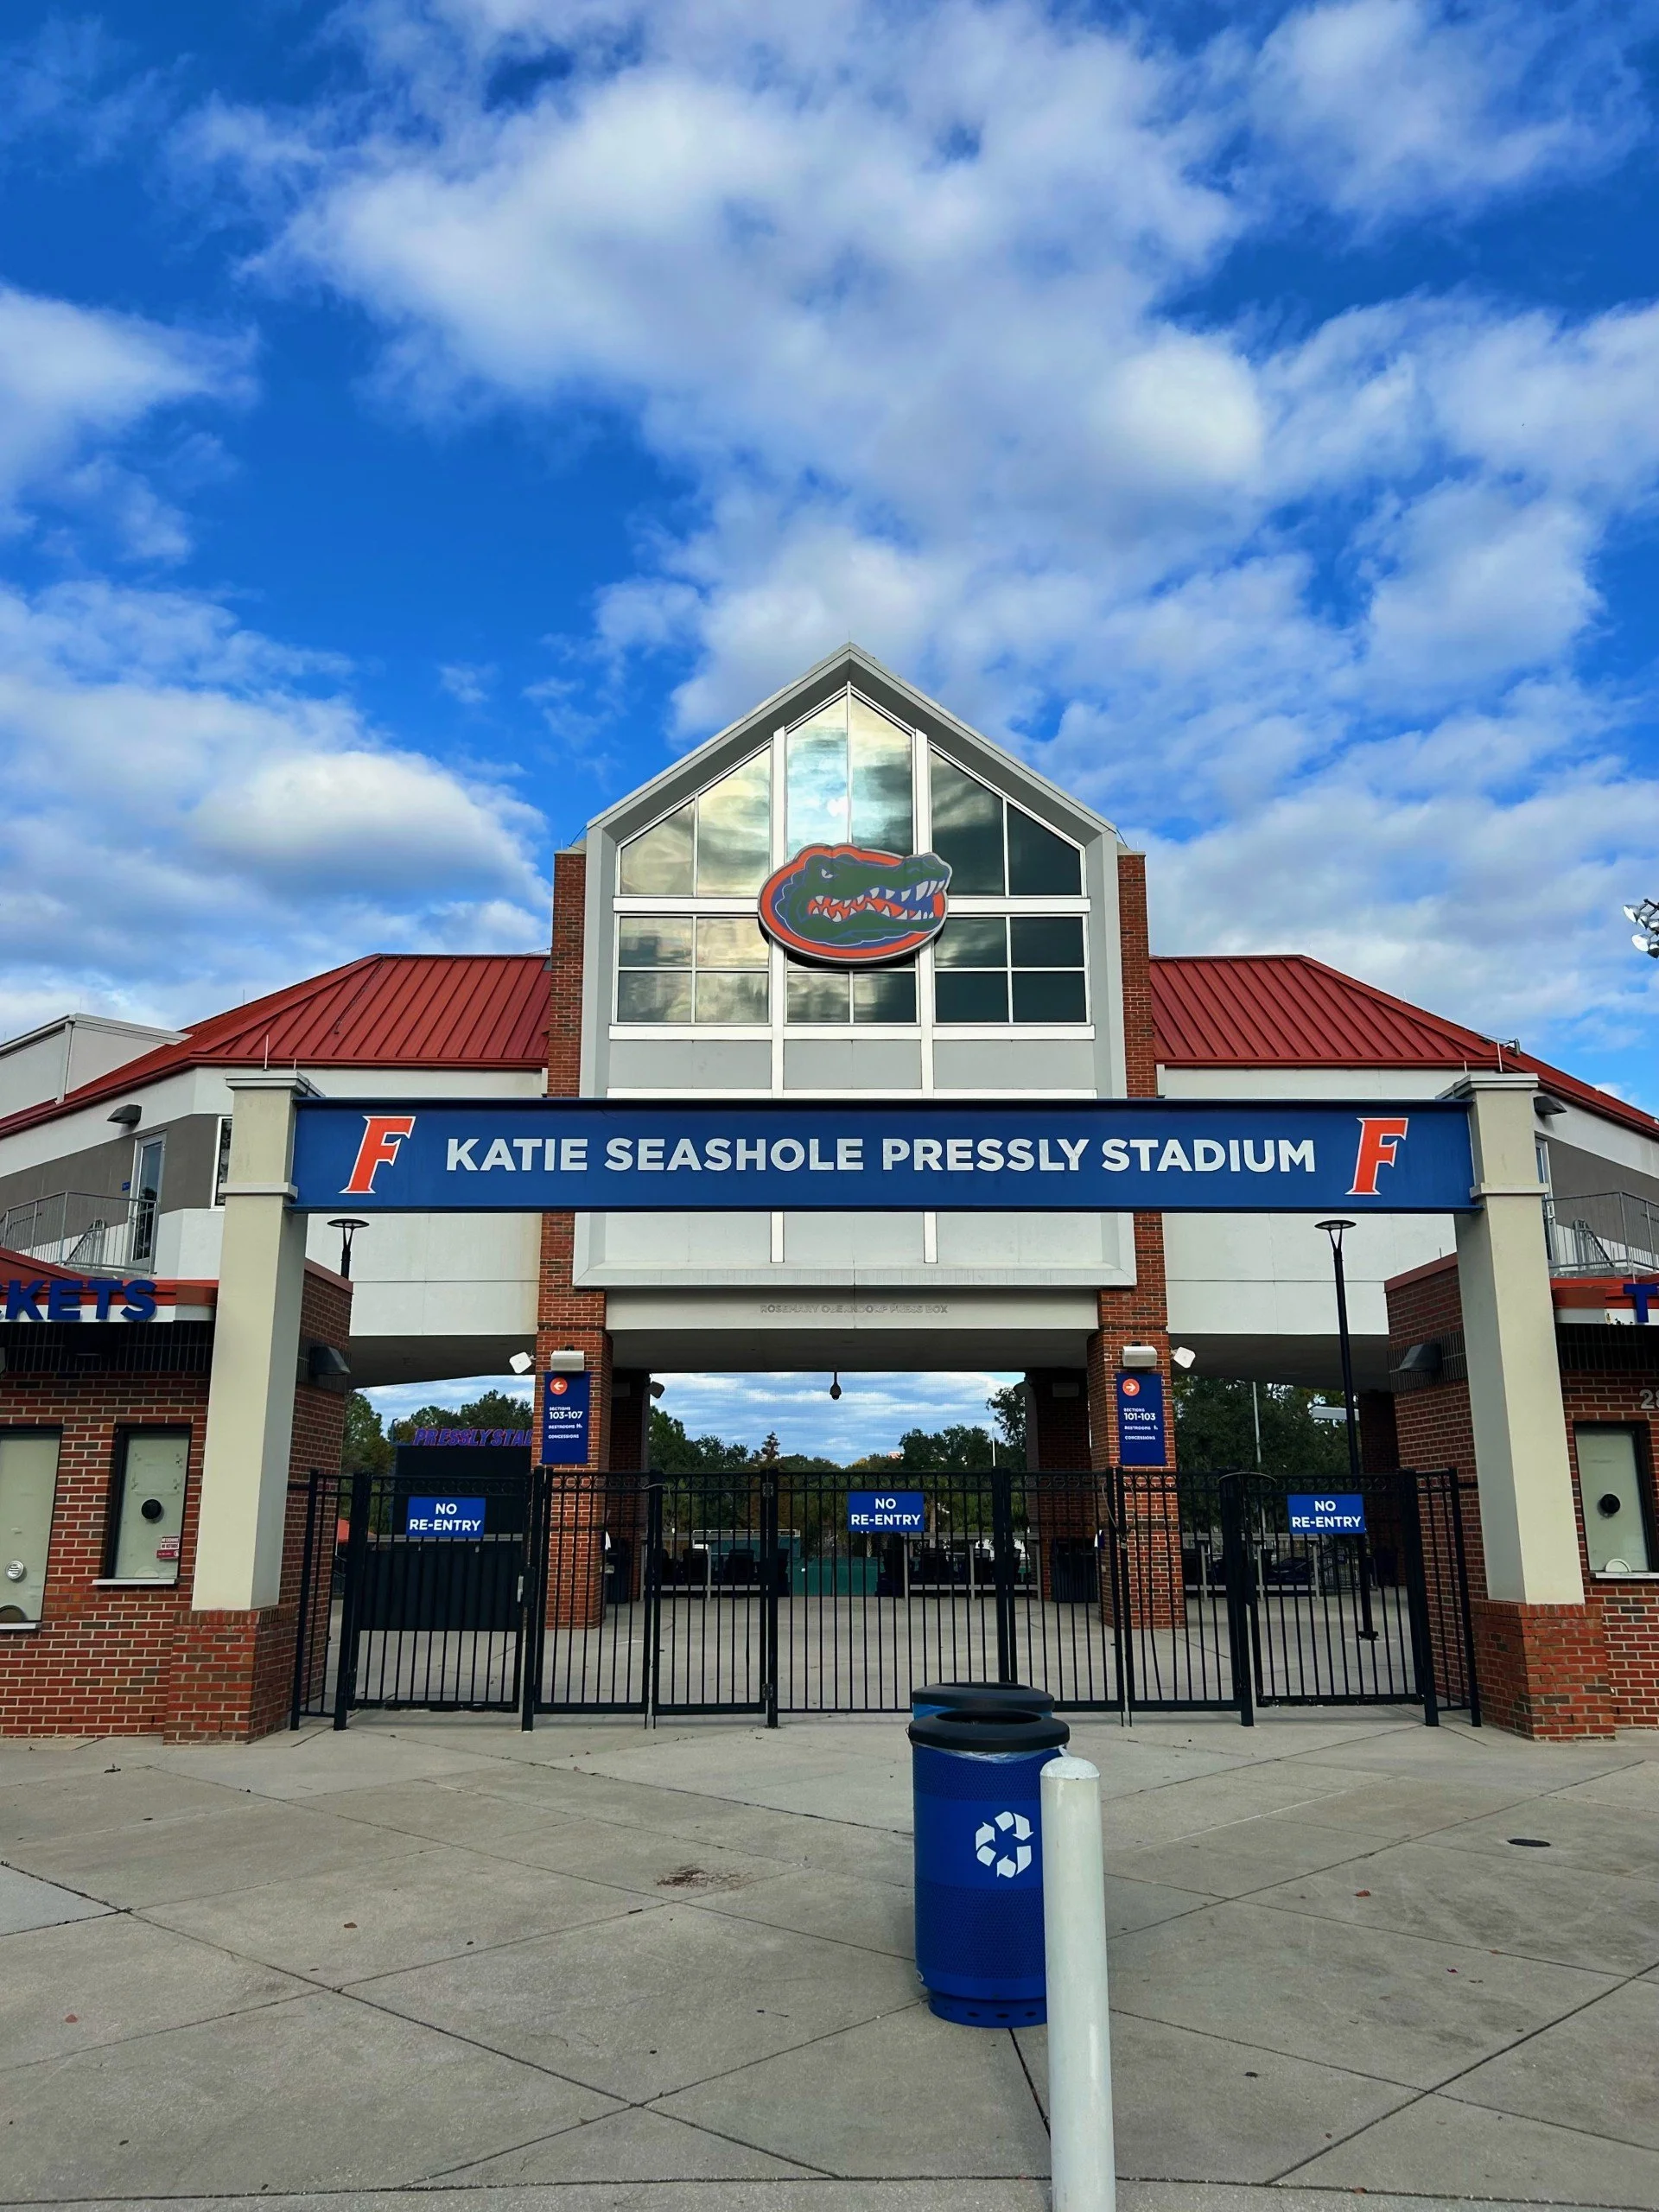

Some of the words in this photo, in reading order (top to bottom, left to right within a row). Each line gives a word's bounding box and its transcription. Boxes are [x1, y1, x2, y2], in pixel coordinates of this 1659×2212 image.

[339, 1116, 416, 1194] F
[446, 1138, 588, 1171] KATIE
[604, 1137, 864, 1172] SEASHOLE
[882, 1138, 1089, 1172] PRESSLY
[1102, 1138, 1315, 1173] STADIUM
[1345, 1117, 1409, 1196] F
[0, 1279, 157, 1321] KETS
[549, 1411, 583, 1420] 103-107
[1123, 1412, 1156, 1421] 101-103
[413, 1428, 493, 1446] PRESSLY
[435, 1503, 458, 1515] NO
[874, 1497, 897, 1510] NO
[1314, 1500, 1337, 1512] NO
[409, 1518, 482, 1532] RE-ENTRY
[850, 1514, 921, 1526] RE-ENTRY
[1291, 1516, 1362, 1528] RE-ENTRY
